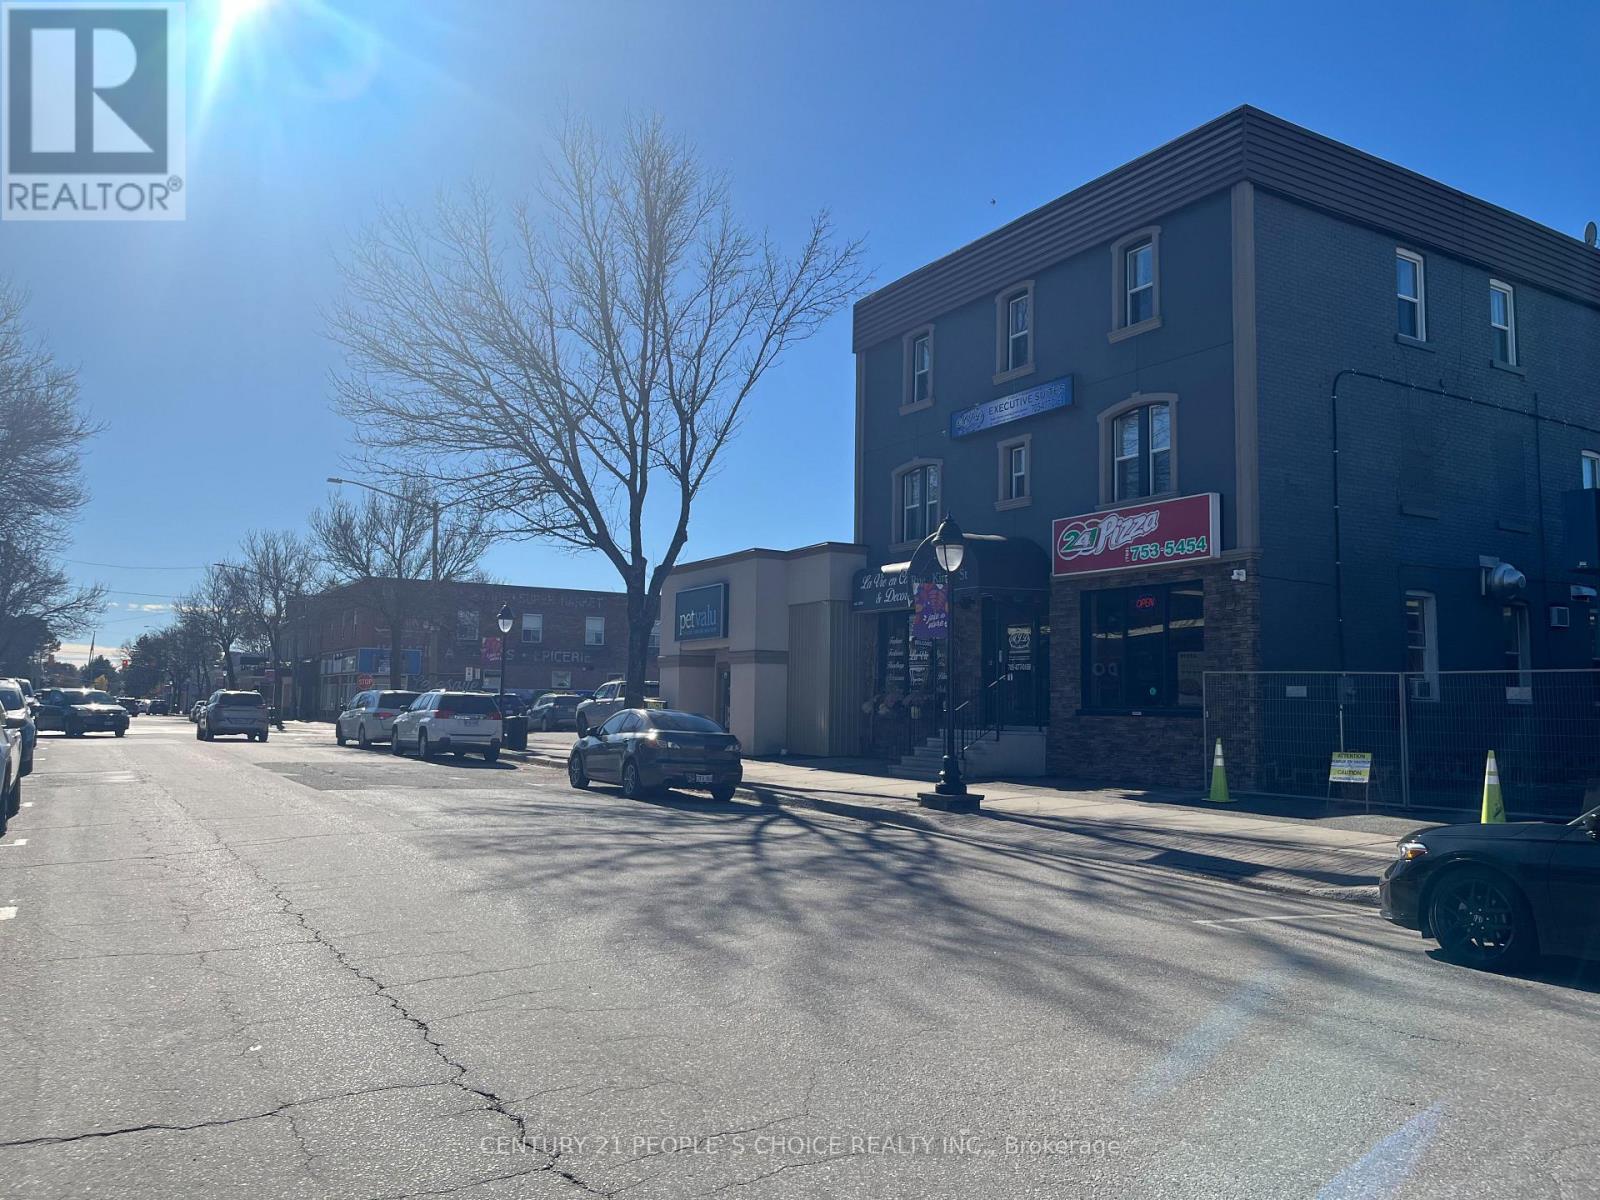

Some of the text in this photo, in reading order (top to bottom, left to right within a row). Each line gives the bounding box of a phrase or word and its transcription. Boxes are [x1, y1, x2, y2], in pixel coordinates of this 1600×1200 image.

[988, 395, 1032, 415] EXECUTIVE
[1094, 510, 1160, 555] Pizza
[1130, 536, 1207, 561] 753-5454
[359, 678, 373, 686] STOP
